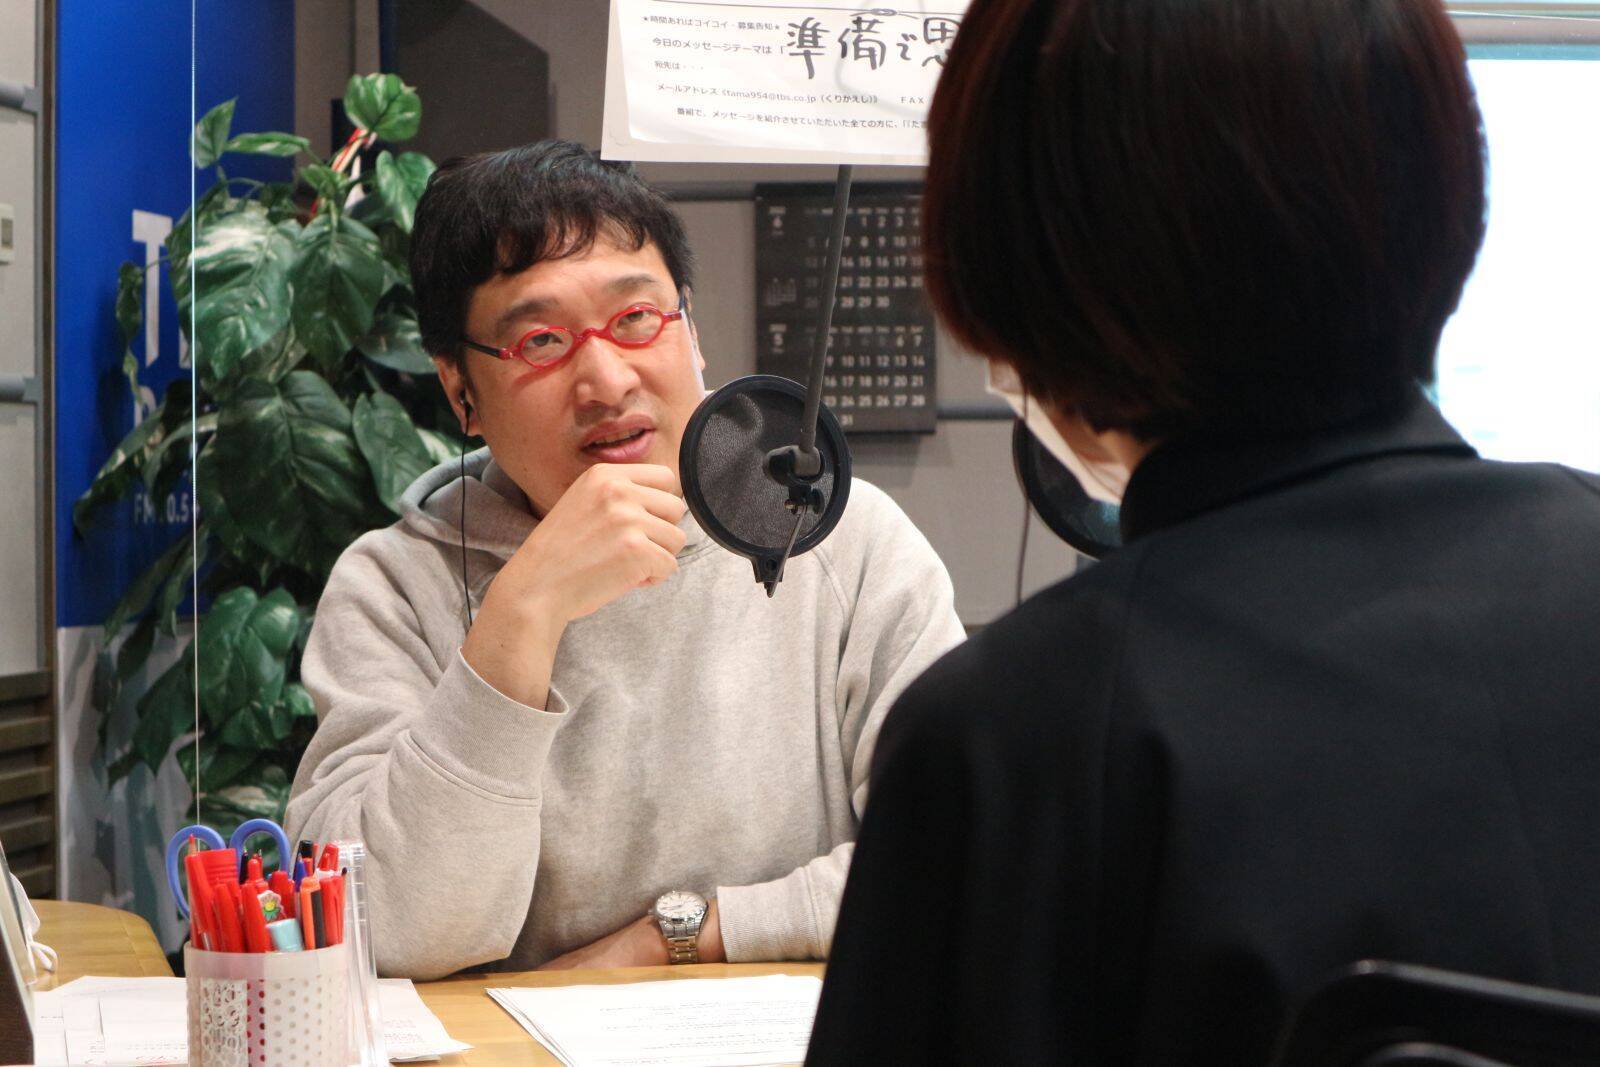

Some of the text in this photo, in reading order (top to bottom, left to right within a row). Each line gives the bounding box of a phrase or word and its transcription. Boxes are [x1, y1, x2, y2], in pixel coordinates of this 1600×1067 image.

[878, 216, 886, 227] 2
[895, 216, 904, 227] 3
[877, 257, 889, 267] 16
[895, 256, 906, 266] 17
[896, 336, 905, 347] 6
[914, 335, 922, 347] 7
[878, 356, 889, 366] 12
[913, 356, 924, 365] 14
